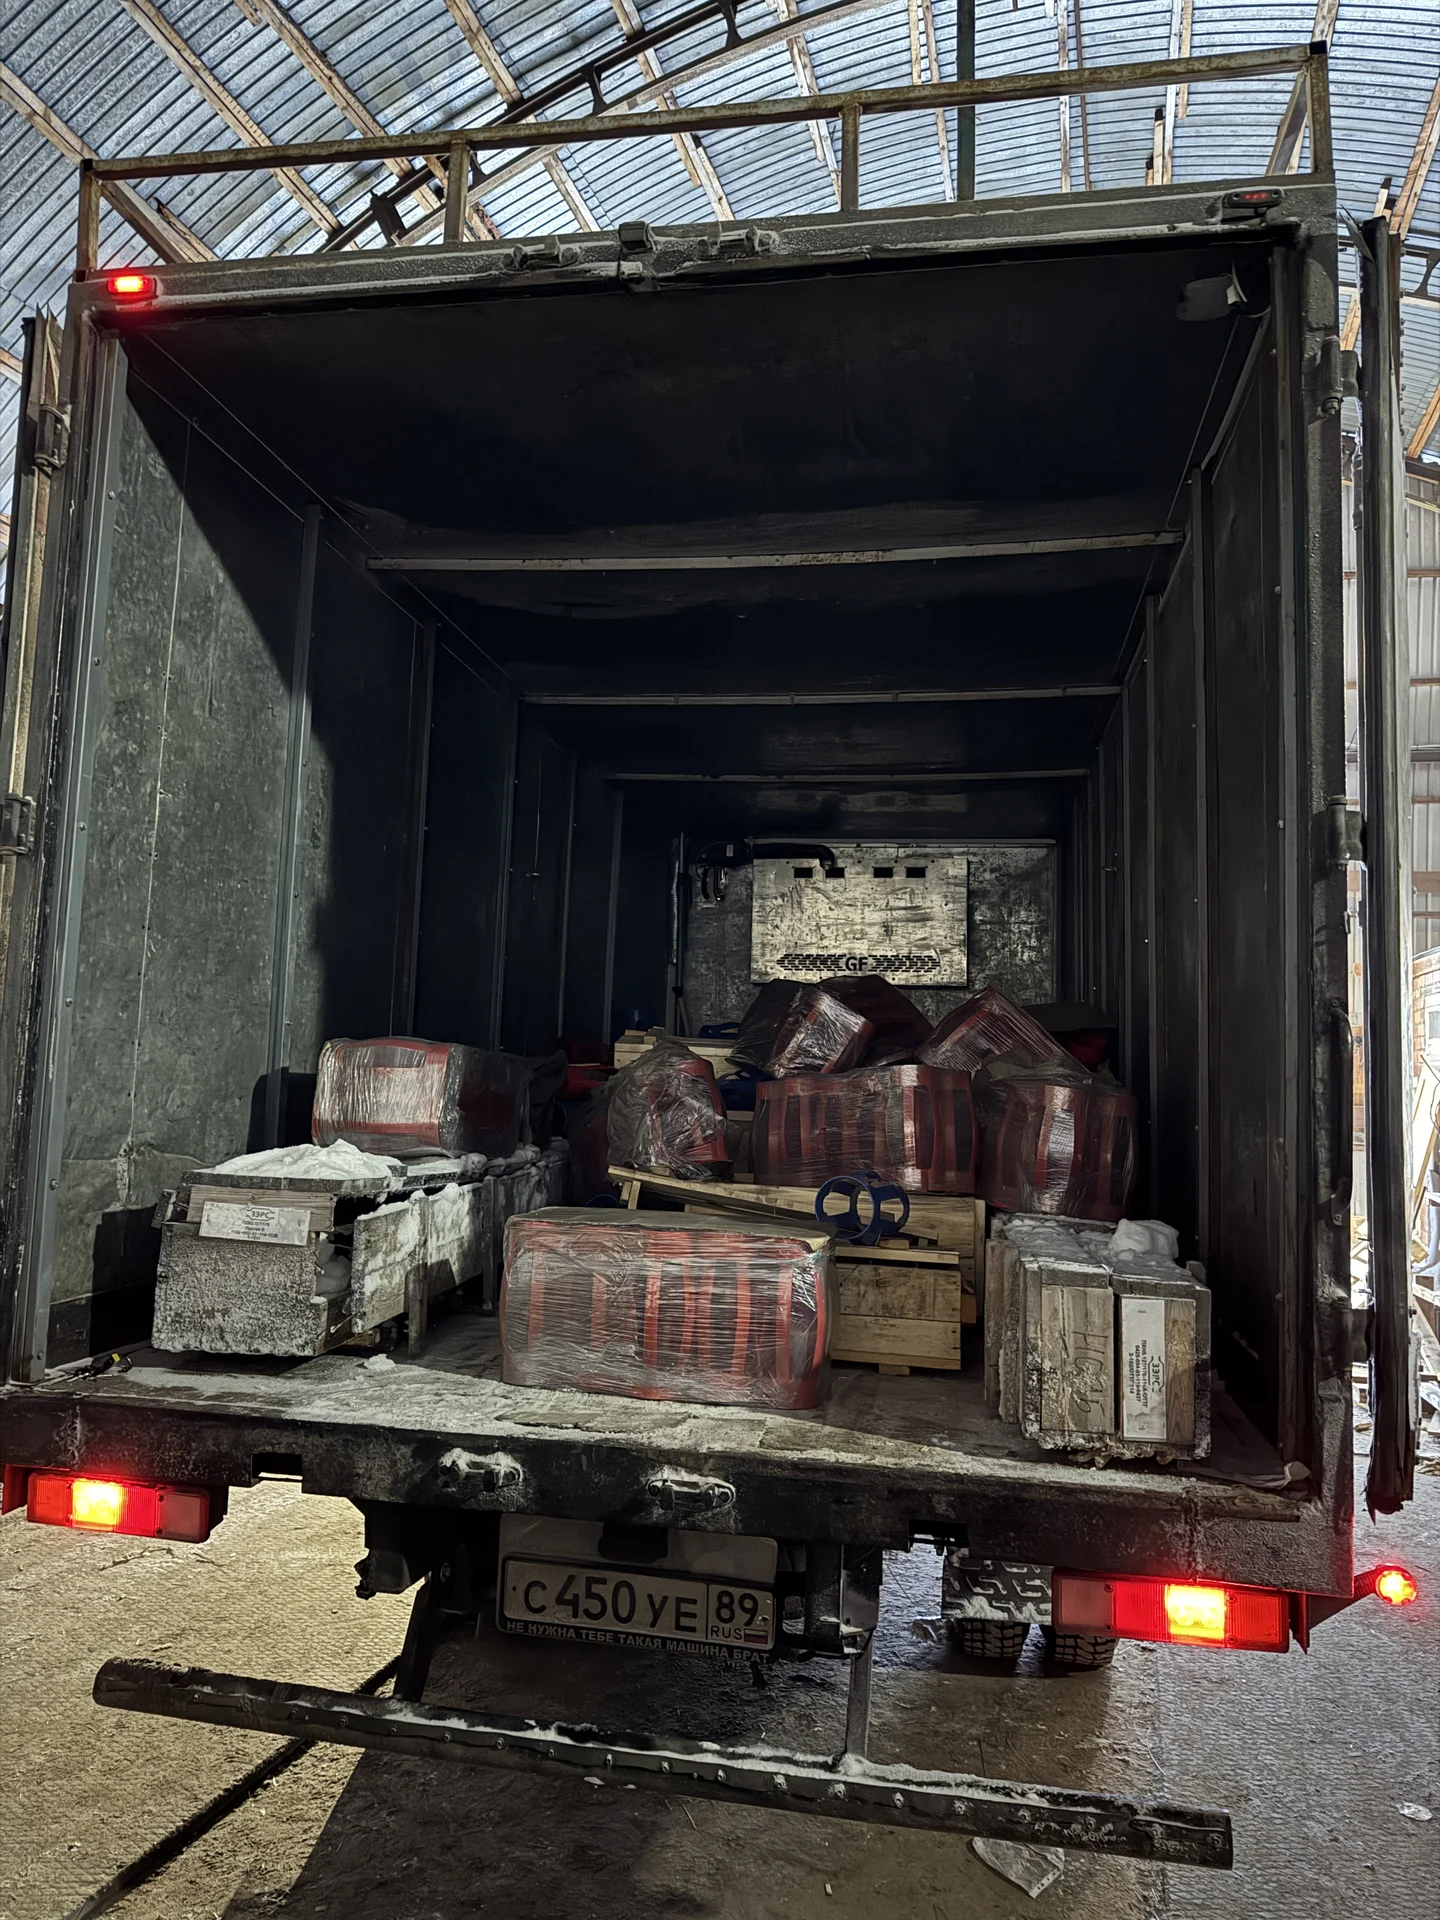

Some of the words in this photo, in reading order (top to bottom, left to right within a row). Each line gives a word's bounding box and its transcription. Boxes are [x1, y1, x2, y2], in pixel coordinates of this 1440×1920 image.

[845, 956, 868, 972] GF
[1152, 1362, 1160, 1387] ЗЭРС
[715, 1589, 759, 1627] 89
[506, 1621, 525, 1632] НЕ
[528, 1623, 577, 1640] НУЖНА
[579, 1629, 614, 1643] ТЕБЕ
[617, 1633, 663, 1649] ТАКАЯ
[666, 1639, 729, 1659] МАШИНА
[733, 1648, 770, 1664] БРАТ
[710, 1625, 743, 1640] RUS
